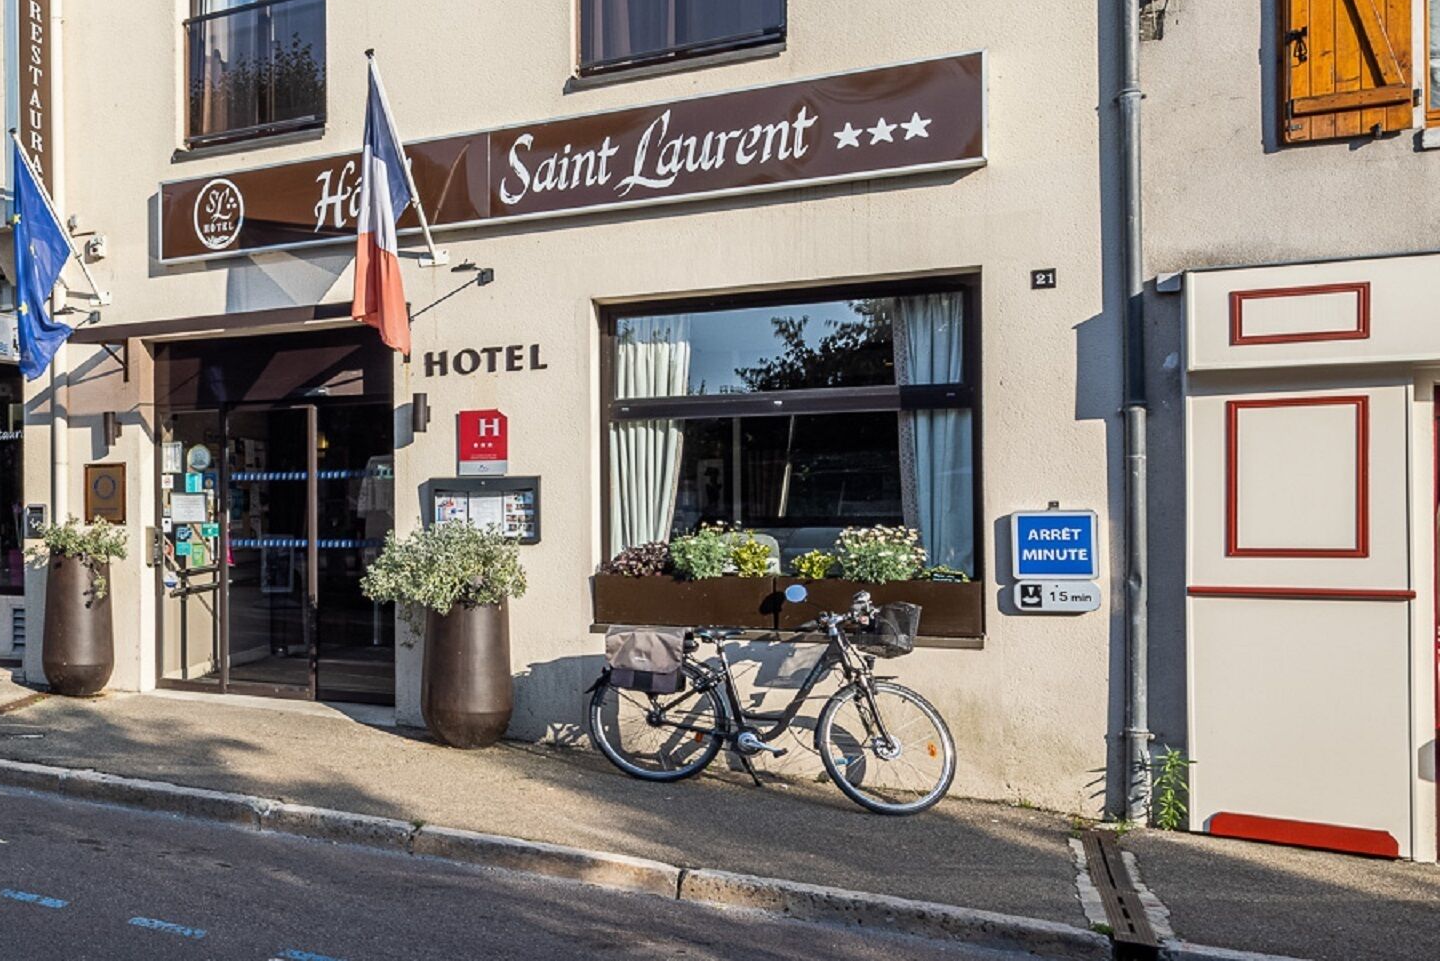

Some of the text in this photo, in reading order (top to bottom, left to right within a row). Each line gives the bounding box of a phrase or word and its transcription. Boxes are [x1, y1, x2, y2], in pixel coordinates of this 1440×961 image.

[28, 0, 43, 178] RESTAURA
[500, 134, 619, 205] Saint
[1035, 272, 1054, 285] 21
[423, 344, 548, 377] HOTEL
[479, 418, 500, 437] H
[1027, 527, 1083, 541] ARRÊT
[1022, 548, 1089, 561] MINUTE
[1049, 591, 1093, 602] 15 min
